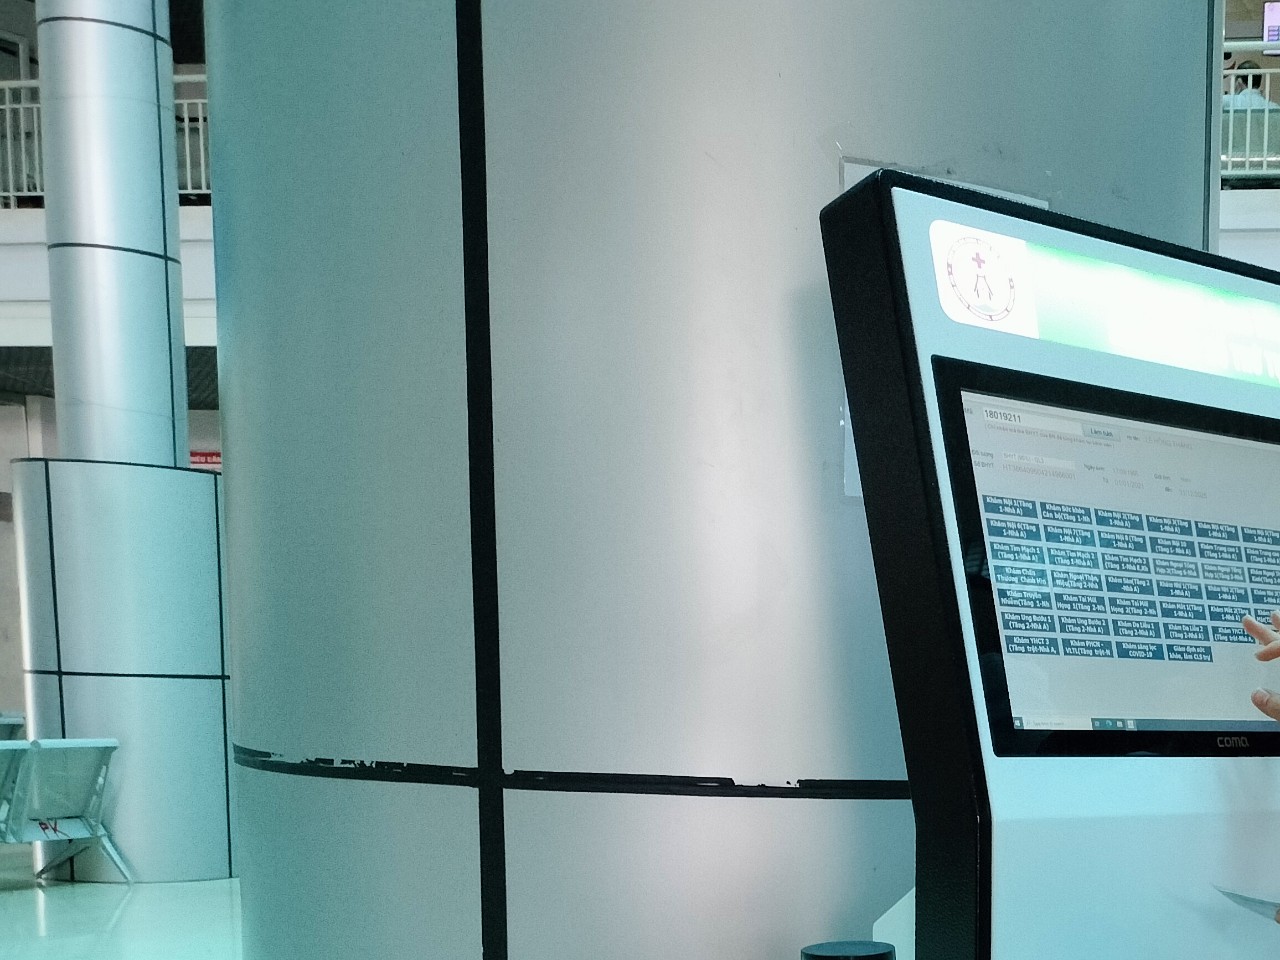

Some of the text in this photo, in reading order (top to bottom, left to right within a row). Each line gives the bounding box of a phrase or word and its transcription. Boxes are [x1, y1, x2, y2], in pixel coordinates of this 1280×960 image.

[985, 409, 1021, 423] 18019211
[986, 496, 1003, 505] Khám
[1046, 504, 1061, 512] Khám
[990, 519, 1007, 528] Khám
[993, 543, 1009, 551] Khám
